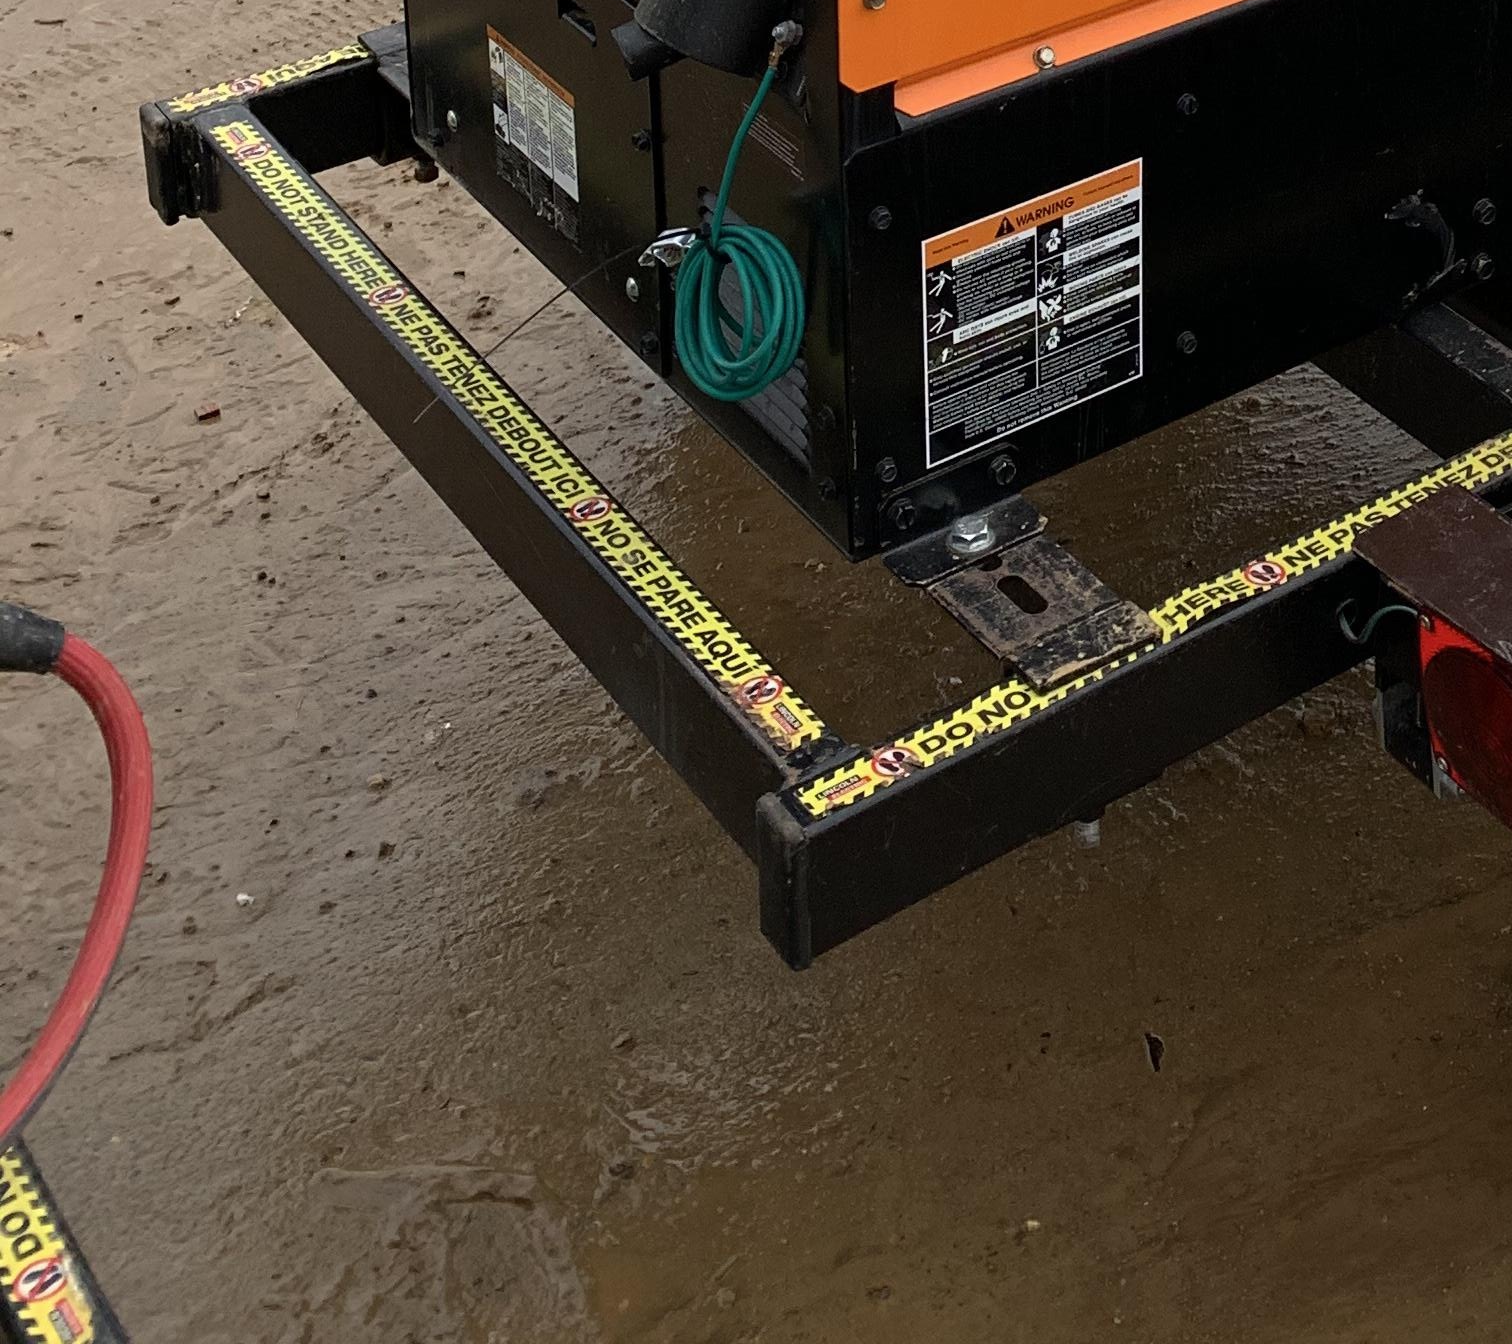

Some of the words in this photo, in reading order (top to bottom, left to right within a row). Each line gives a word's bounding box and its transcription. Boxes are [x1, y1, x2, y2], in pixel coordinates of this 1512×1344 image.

[252, 158, 279, 185] DO
[273, 179, 309, 210] NOT
[297, 203, 350, 250] STAND
[339, 244, 386, 289] HERE
[1016, 197, 1075, 227] WARNING
[391, 303, 421, 327] NE
[417, 324, 449, 356] PAS
[441, 352, 500, 406] TENEZ
[490, 404, 562, 474] DEBOUT
[550, 470, 585, 500] ICI
[1006, 419, 1016, 429] not
[1041, 404, 1052, 414] this
[1053, 393, 1078, 410] Warning
[1284, 540, 1326, 568] NE
[1333, 510, 1388, 546] PAS
[1394, 464, 1478, 508] TENEZ
[593, 517, 631, 549] NO
[620, 548, 659, 578] SE
[650, 574, 708, 633] PARE
[1162, 579, 1248, 624] HERE
[917, 721, 975, 755] DO
[977, 690, 1031, 725] NO
[815, 775, 860, 801] LINCOLN
[0, 1211, 43, 1261] DO
